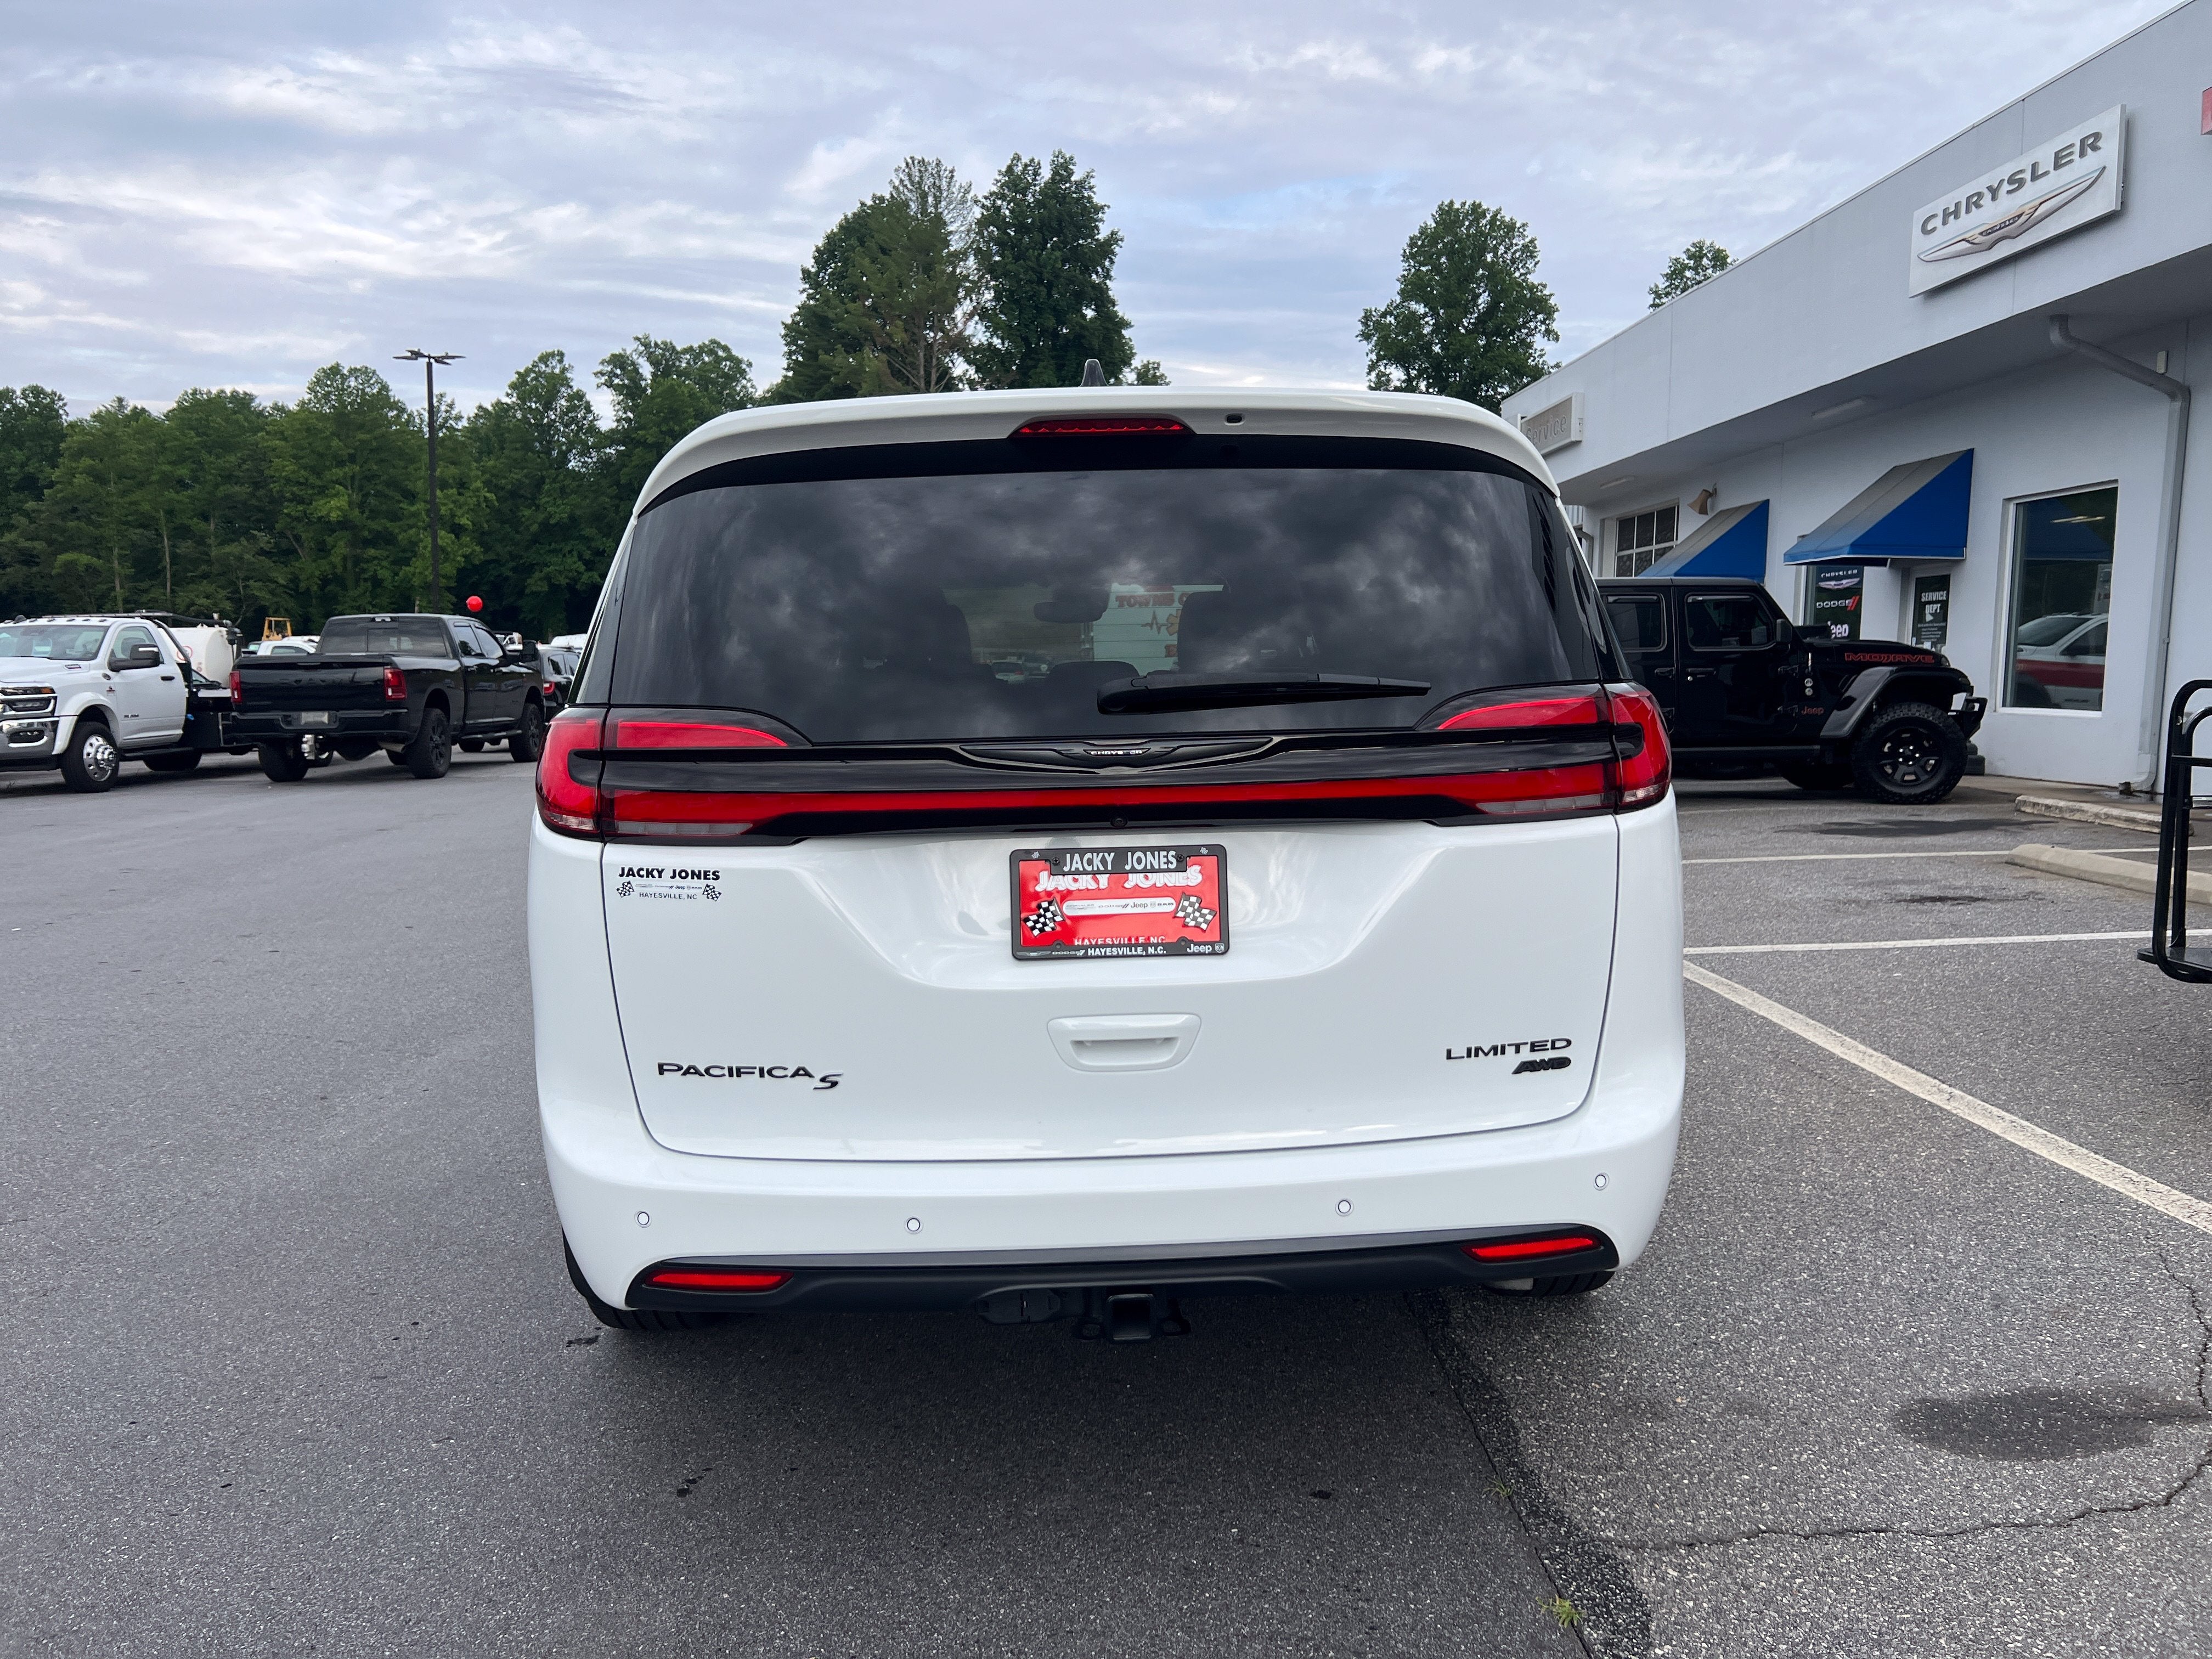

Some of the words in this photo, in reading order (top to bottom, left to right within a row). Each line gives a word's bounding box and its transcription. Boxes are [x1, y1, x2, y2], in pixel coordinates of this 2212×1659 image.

[1921, 131, 2102, 235] CHRYSLER
[1921, 590, 1947, 602] SERVICE
[1816, 599, 1853, 608] DODGE
[1925, 603, 1941, 613] DEPT
[1844, 652, 1935, 663] MOJAVE
[1801, 706, 1825, 715] Jeep
[1063, 852, 1115, 872] JACKY
[1125, 850, 1177, 870] JONES
[618, 867, 665, 878] JACKY
[669, 868, 720, 881] JONES
[639, 892, 685, 900] HAYESVILLE,
[1087, 946, 1146, 956] HAYESVILLE,
[1148, 946, 1167, 955] N.C.
[1187, 944, 1212, 953] Jeep
[1446, 1038, 1572, 1060] LIMITED
[1511, 1057, 1572, 1074] AWD
[657, 1062, 815, 1079] PACIFICA
[812, 1071, 844, 1091] S
